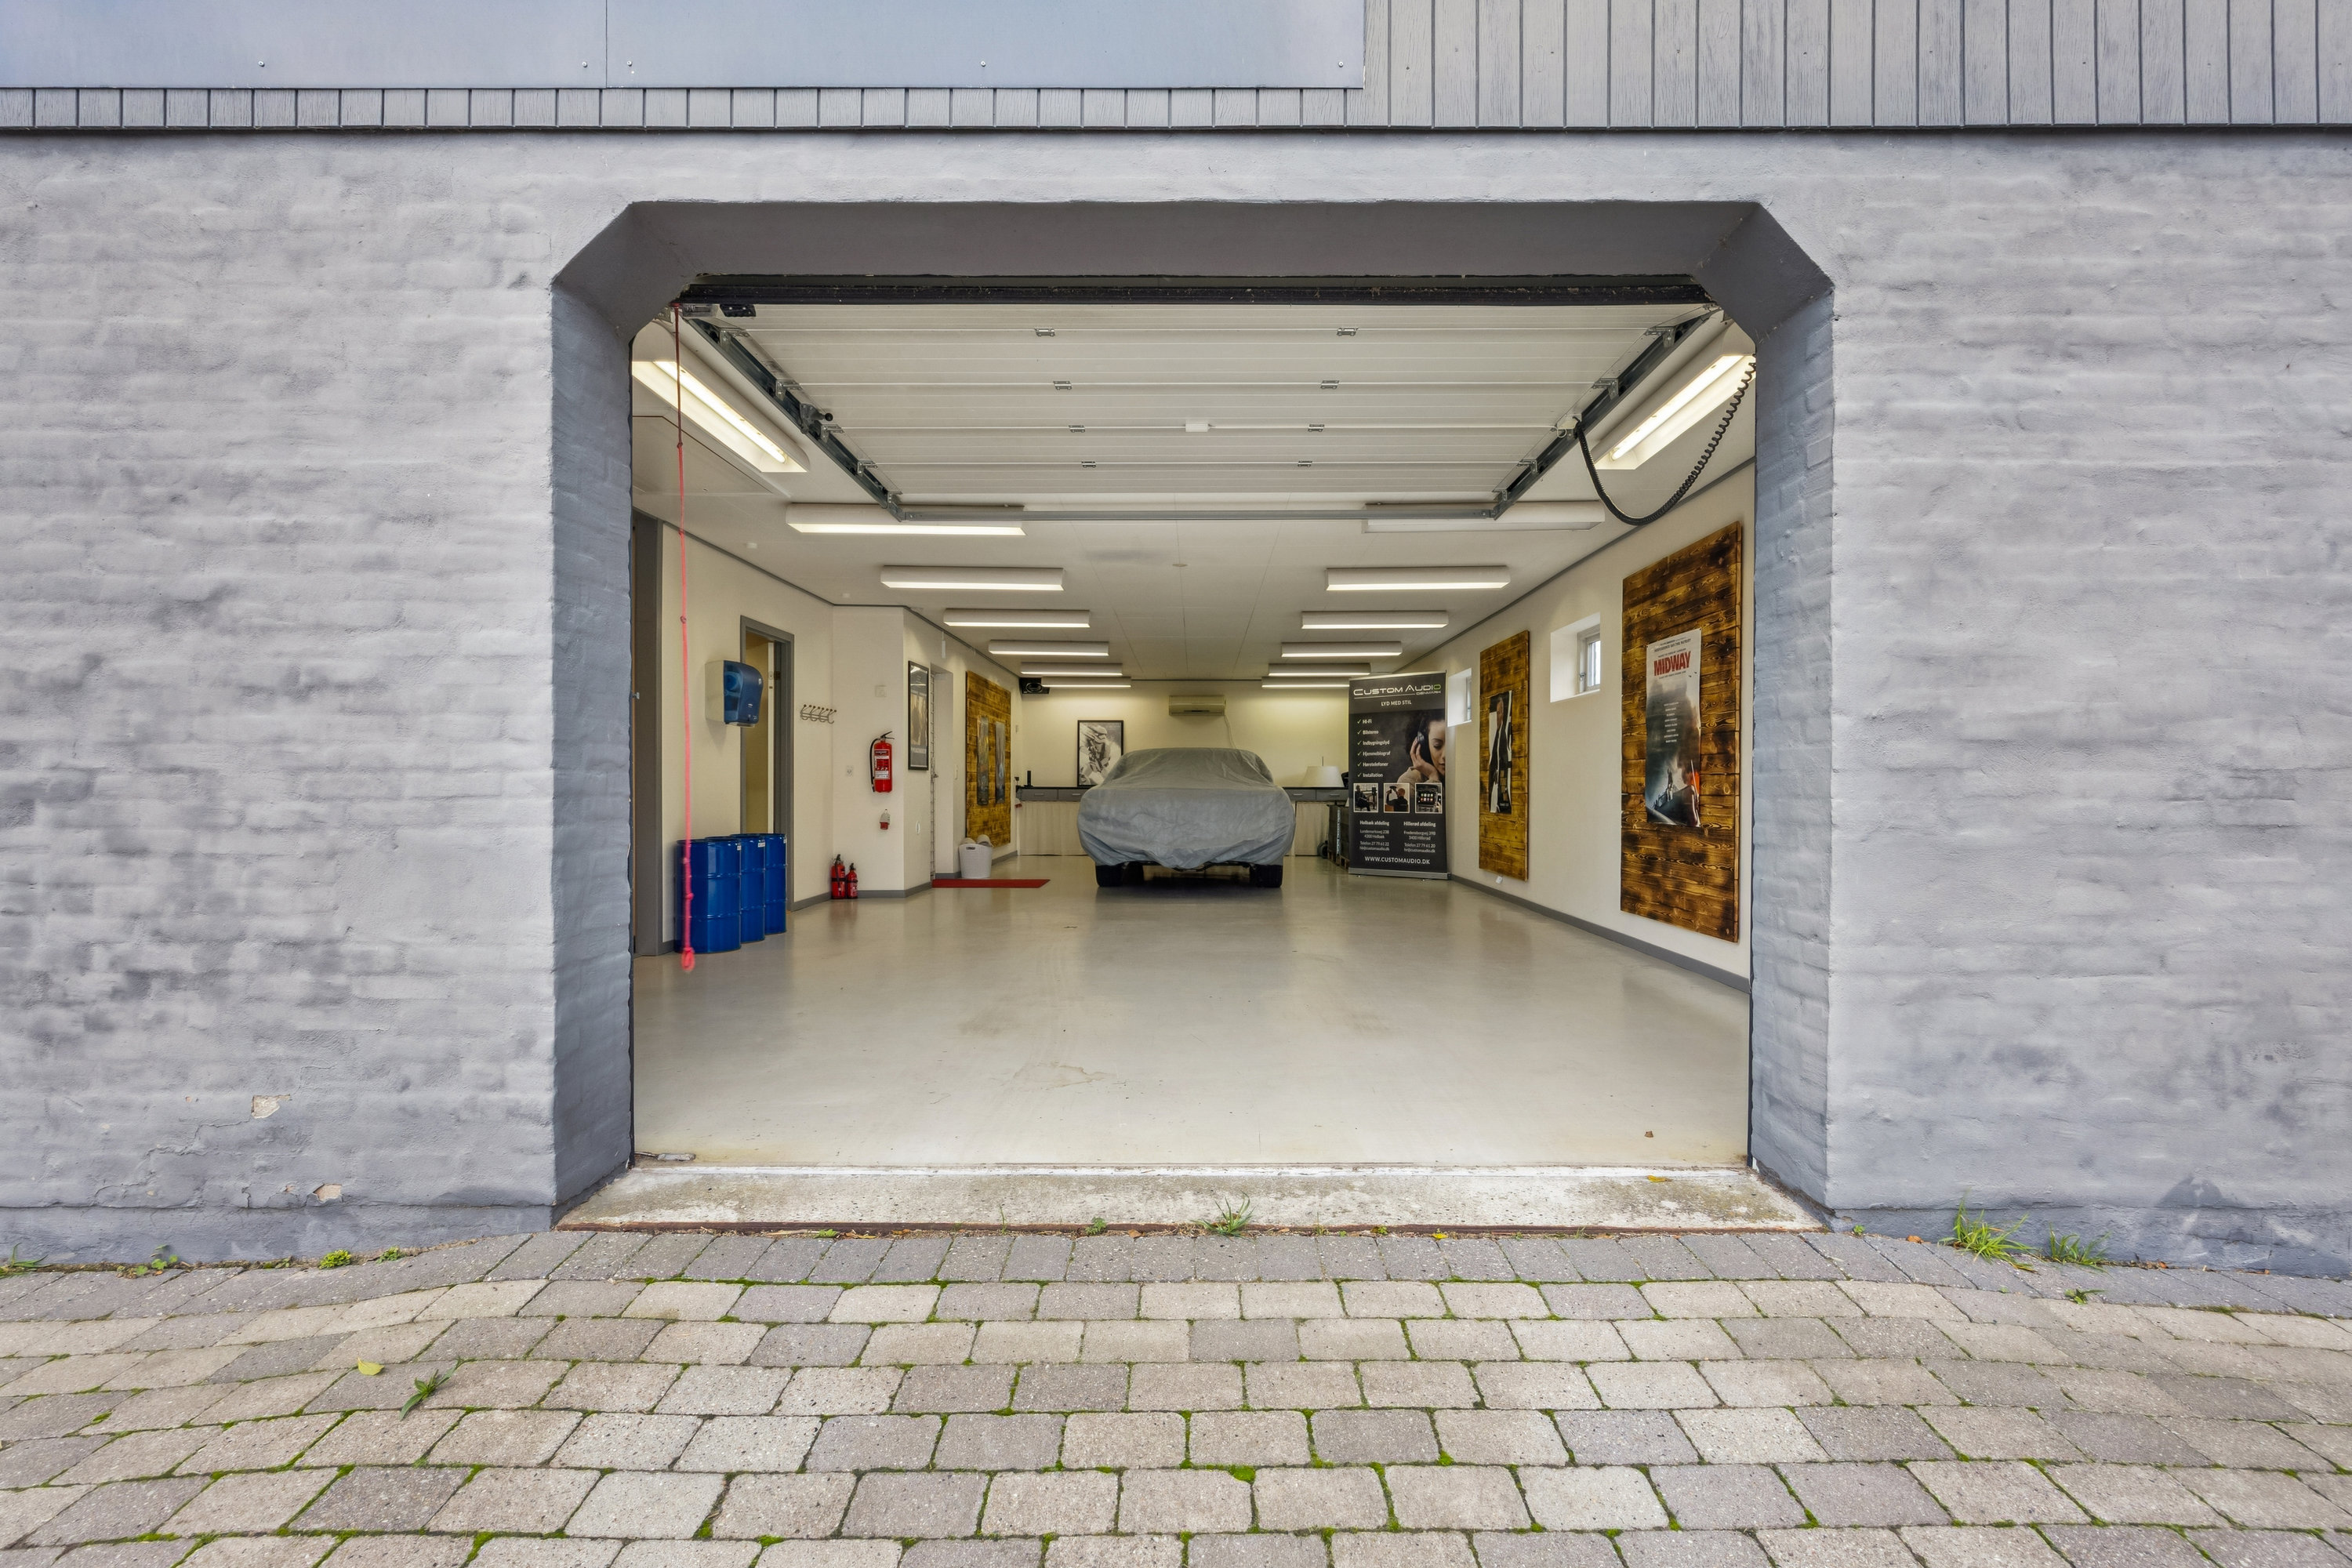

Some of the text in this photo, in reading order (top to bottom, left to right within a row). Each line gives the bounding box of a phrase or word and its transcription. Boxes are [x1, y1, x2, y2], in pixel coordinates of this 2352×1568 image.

[1653, 651, 1691, 676] MIDWAY
[1353, 684, 1441, 696] CUSTOM AUDIO
